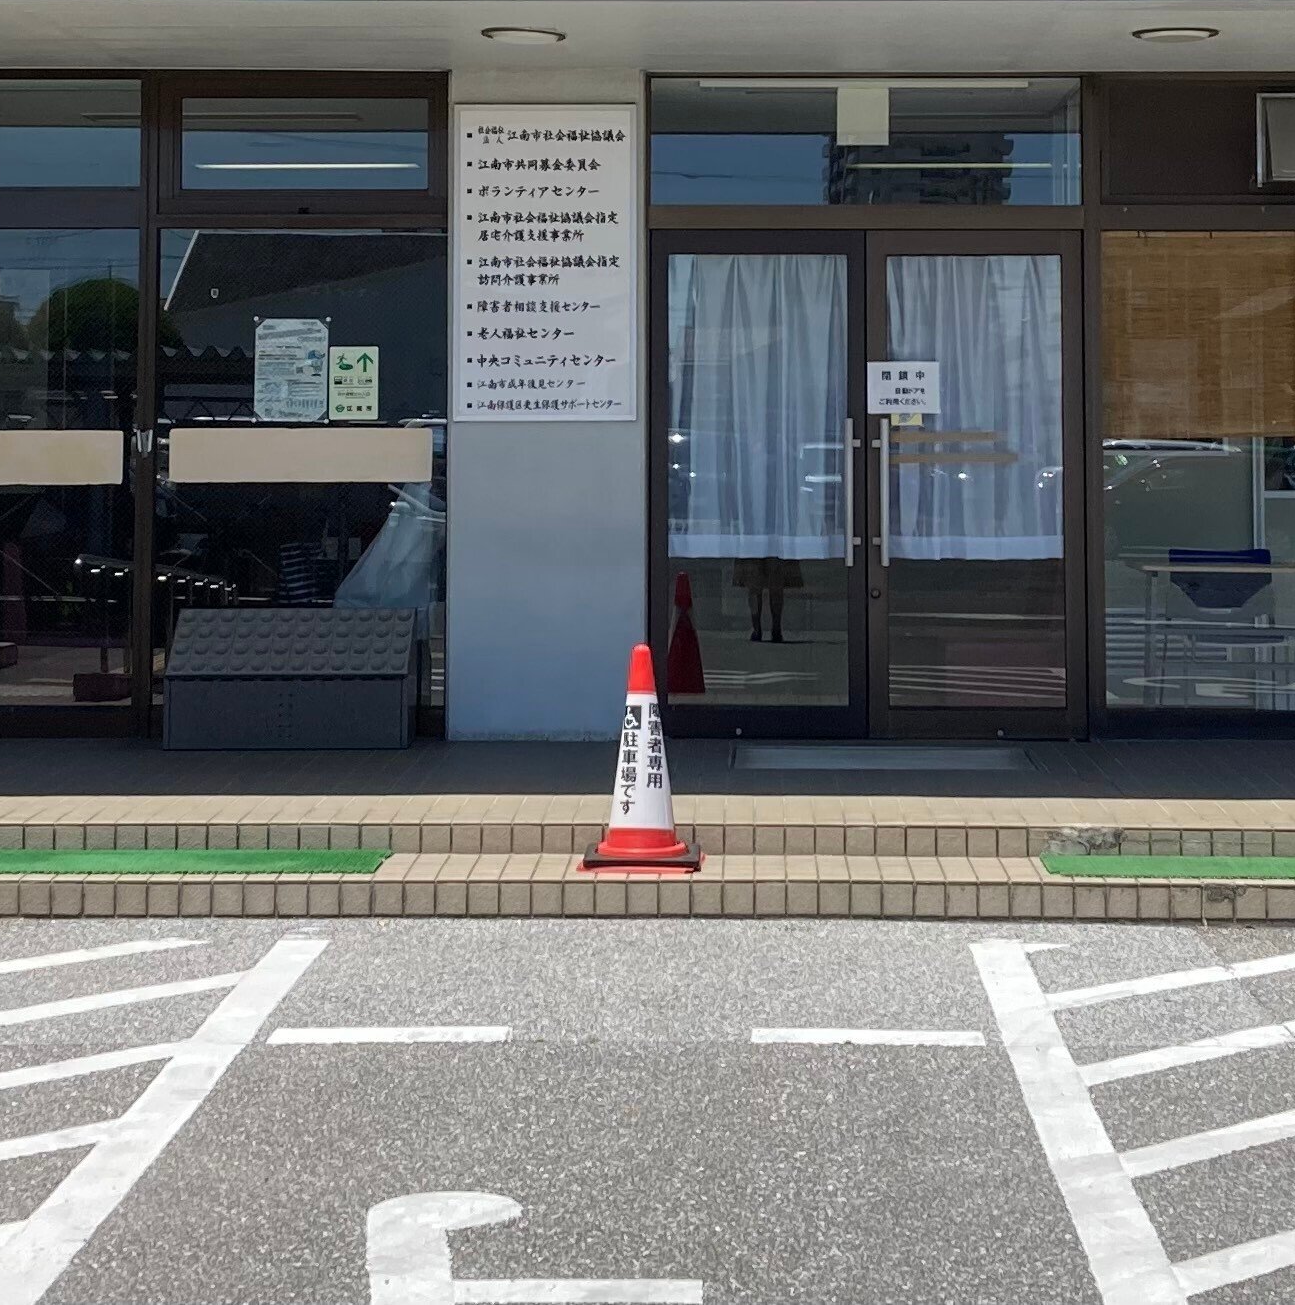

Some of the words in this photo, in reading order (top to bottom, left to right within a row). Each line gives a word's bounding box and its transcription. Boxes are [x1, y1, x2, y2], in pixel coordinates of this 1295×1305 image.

[507, 128, 626, 142] 江南市社会福祉協議会
[478, 158, 601, 171] 江南市共同募金委員会
[478, 185, 599, 198] ボランティアセンター
[478, 211, 619, 225] 江南市社会福祉協議会指定
[478, 229, 584, 242] 居宅介護支援事業所
[478, 255, 620, 269] 江南市社会福祉協議会指定
[477, 273, 560, 286] 訪問介護事業所
[477, 300, 601, 313] 障害者相談支援センター
[477, 327, 575, 340] 老人福祉センター
[477, 354, 616, 368] 中央コミュニティセンター
[881, 370, 925, 381] 閉鎖中
[477, 378, 585, 390] 江南市成年後見センター
[647, 702, 664, 789] 障害者専用
[620, 732, 638, 815] 駐車場です
